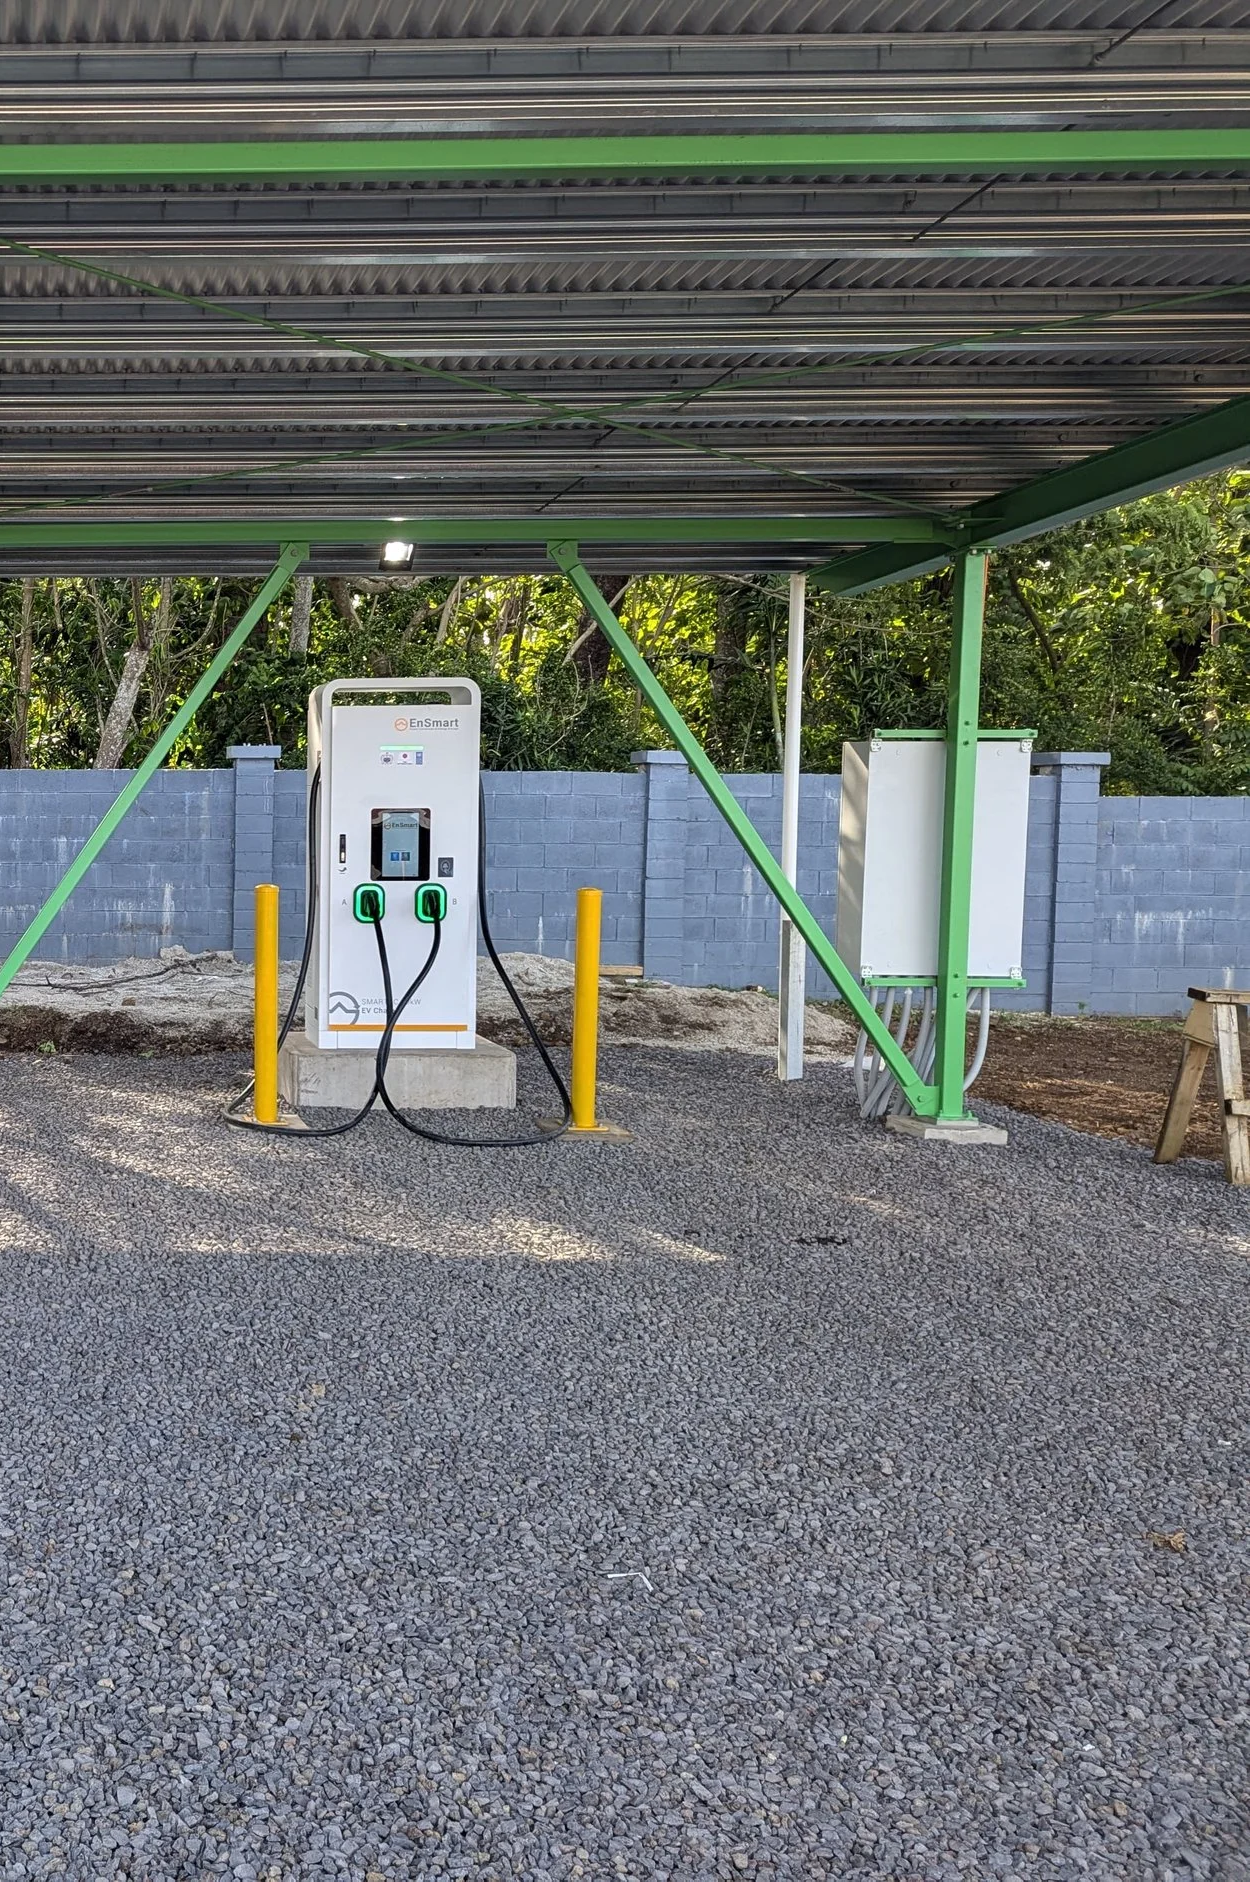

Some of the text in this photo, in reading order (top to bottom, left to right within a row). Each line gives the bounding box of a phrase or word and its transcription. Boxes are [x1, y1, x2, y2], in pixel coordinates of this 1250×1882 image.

[409, 718, 459, 728] EnSmart
[341, 898, 347, 906] A
[452, 898, 458, 906] B
